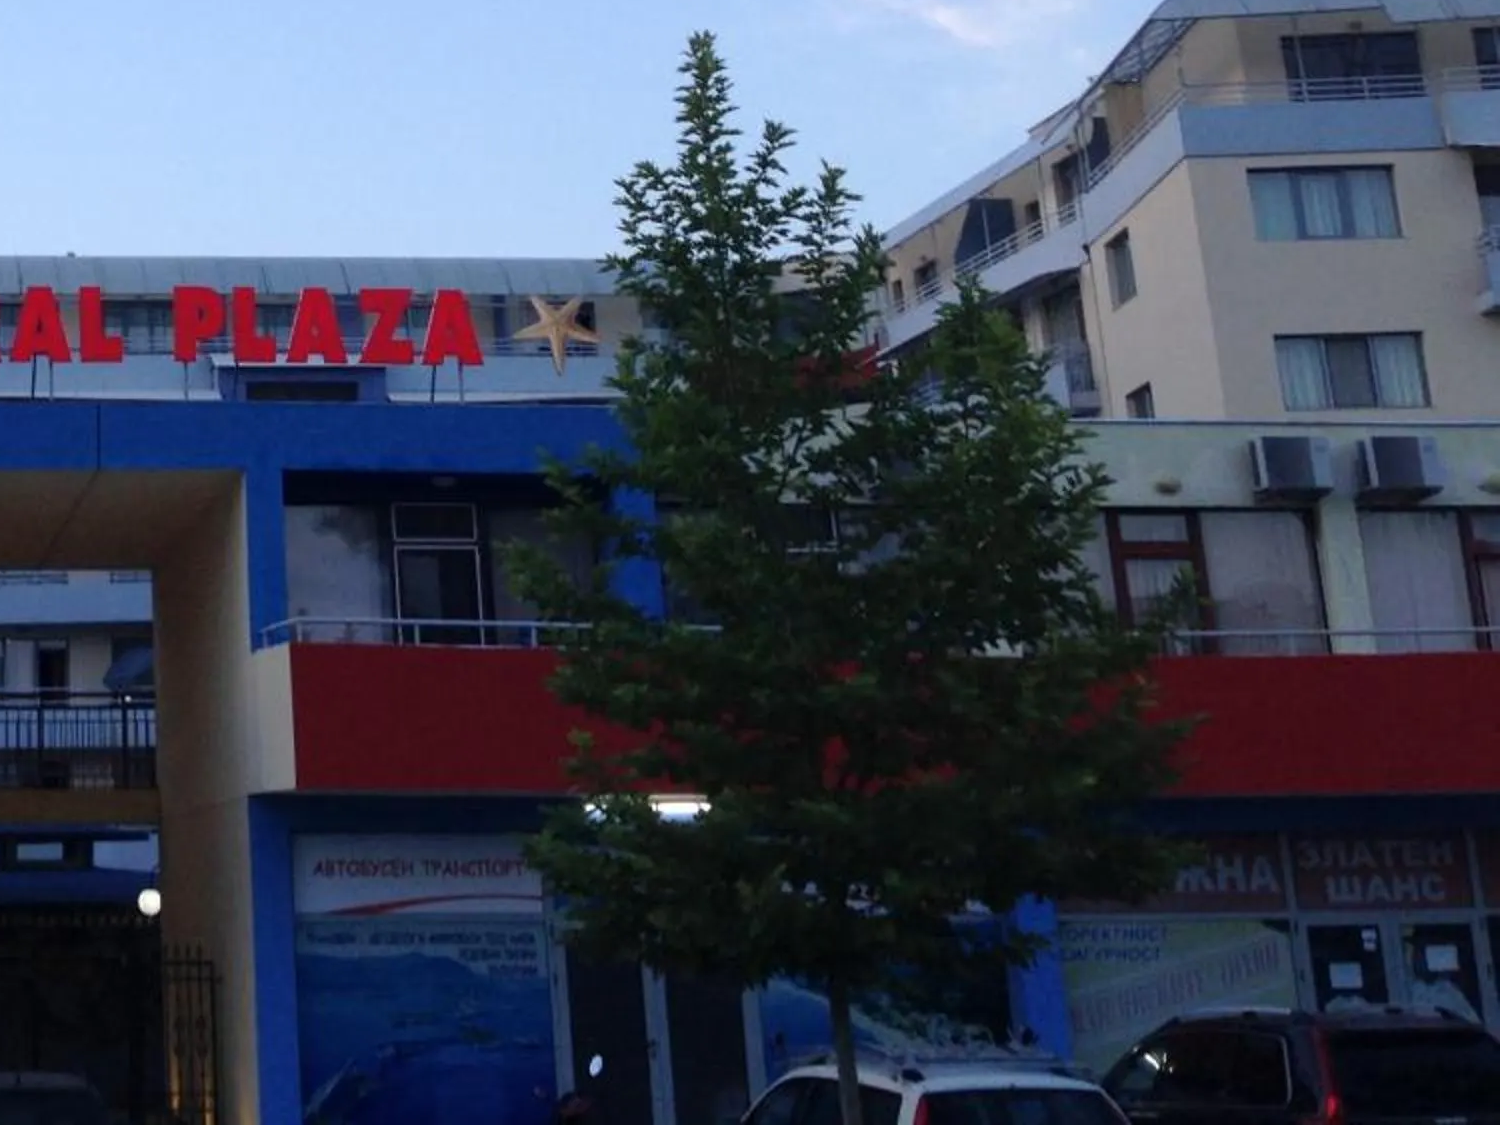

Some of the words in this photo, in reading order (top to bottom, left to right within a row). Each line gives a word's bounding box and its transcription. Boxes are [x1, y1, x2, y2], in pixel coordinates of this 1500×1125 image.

[173, 285, 484, 367] PLAZA
[313, 858, 415, 878] АВТОБУСЕН
[424, 858, 525, 878] ТРАНСПОРТ
[1297, 839, 1454, 869] ЗЛАТЕН
[1326, 873, 1446, 904] ШАНС
